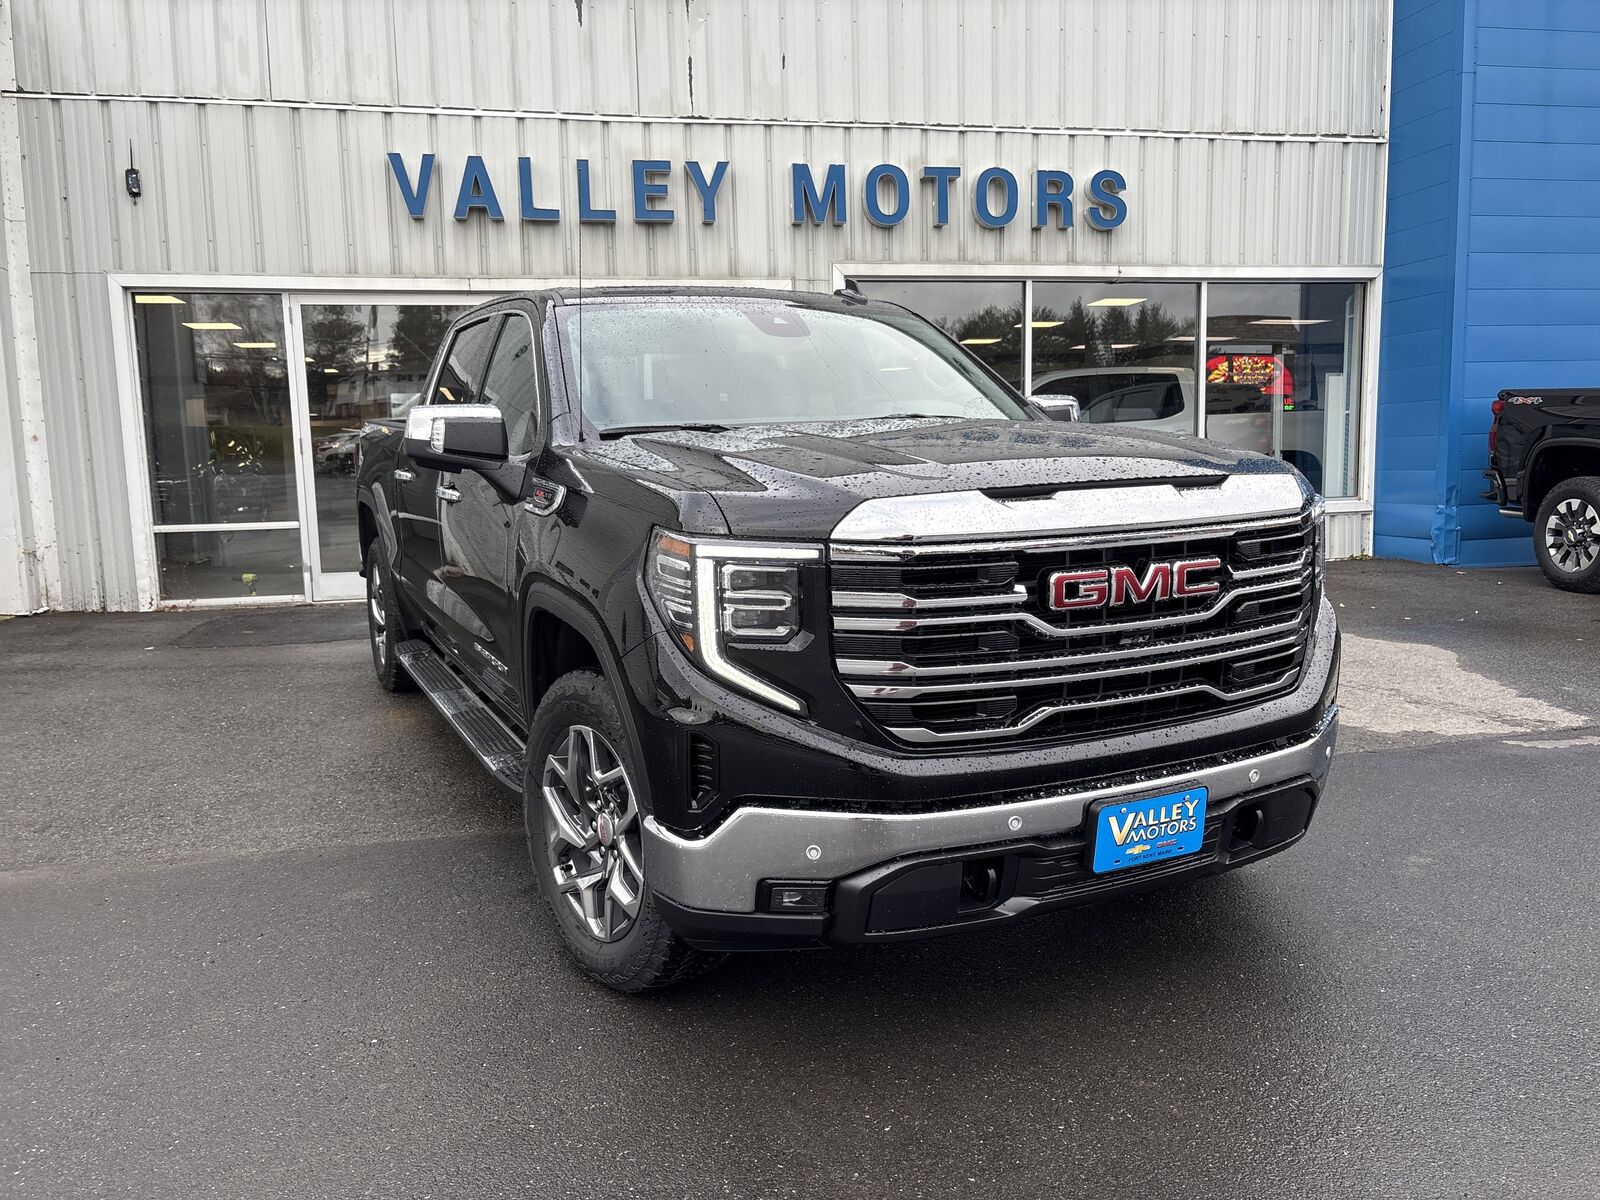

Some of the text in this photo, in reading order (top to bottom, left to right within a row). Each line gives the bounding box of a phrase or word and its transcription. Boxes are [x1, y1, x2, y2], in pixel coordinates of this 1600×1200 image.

[387, 152, 1128, 231] VALLEY MOTORS
[1050, 557, 1221, 611] GMC
[1108, 799, 1200, 846] VALLEY
[1125, 816, 1197, 844] MOTORS
[1156, 839, 1178, 848] GMC
